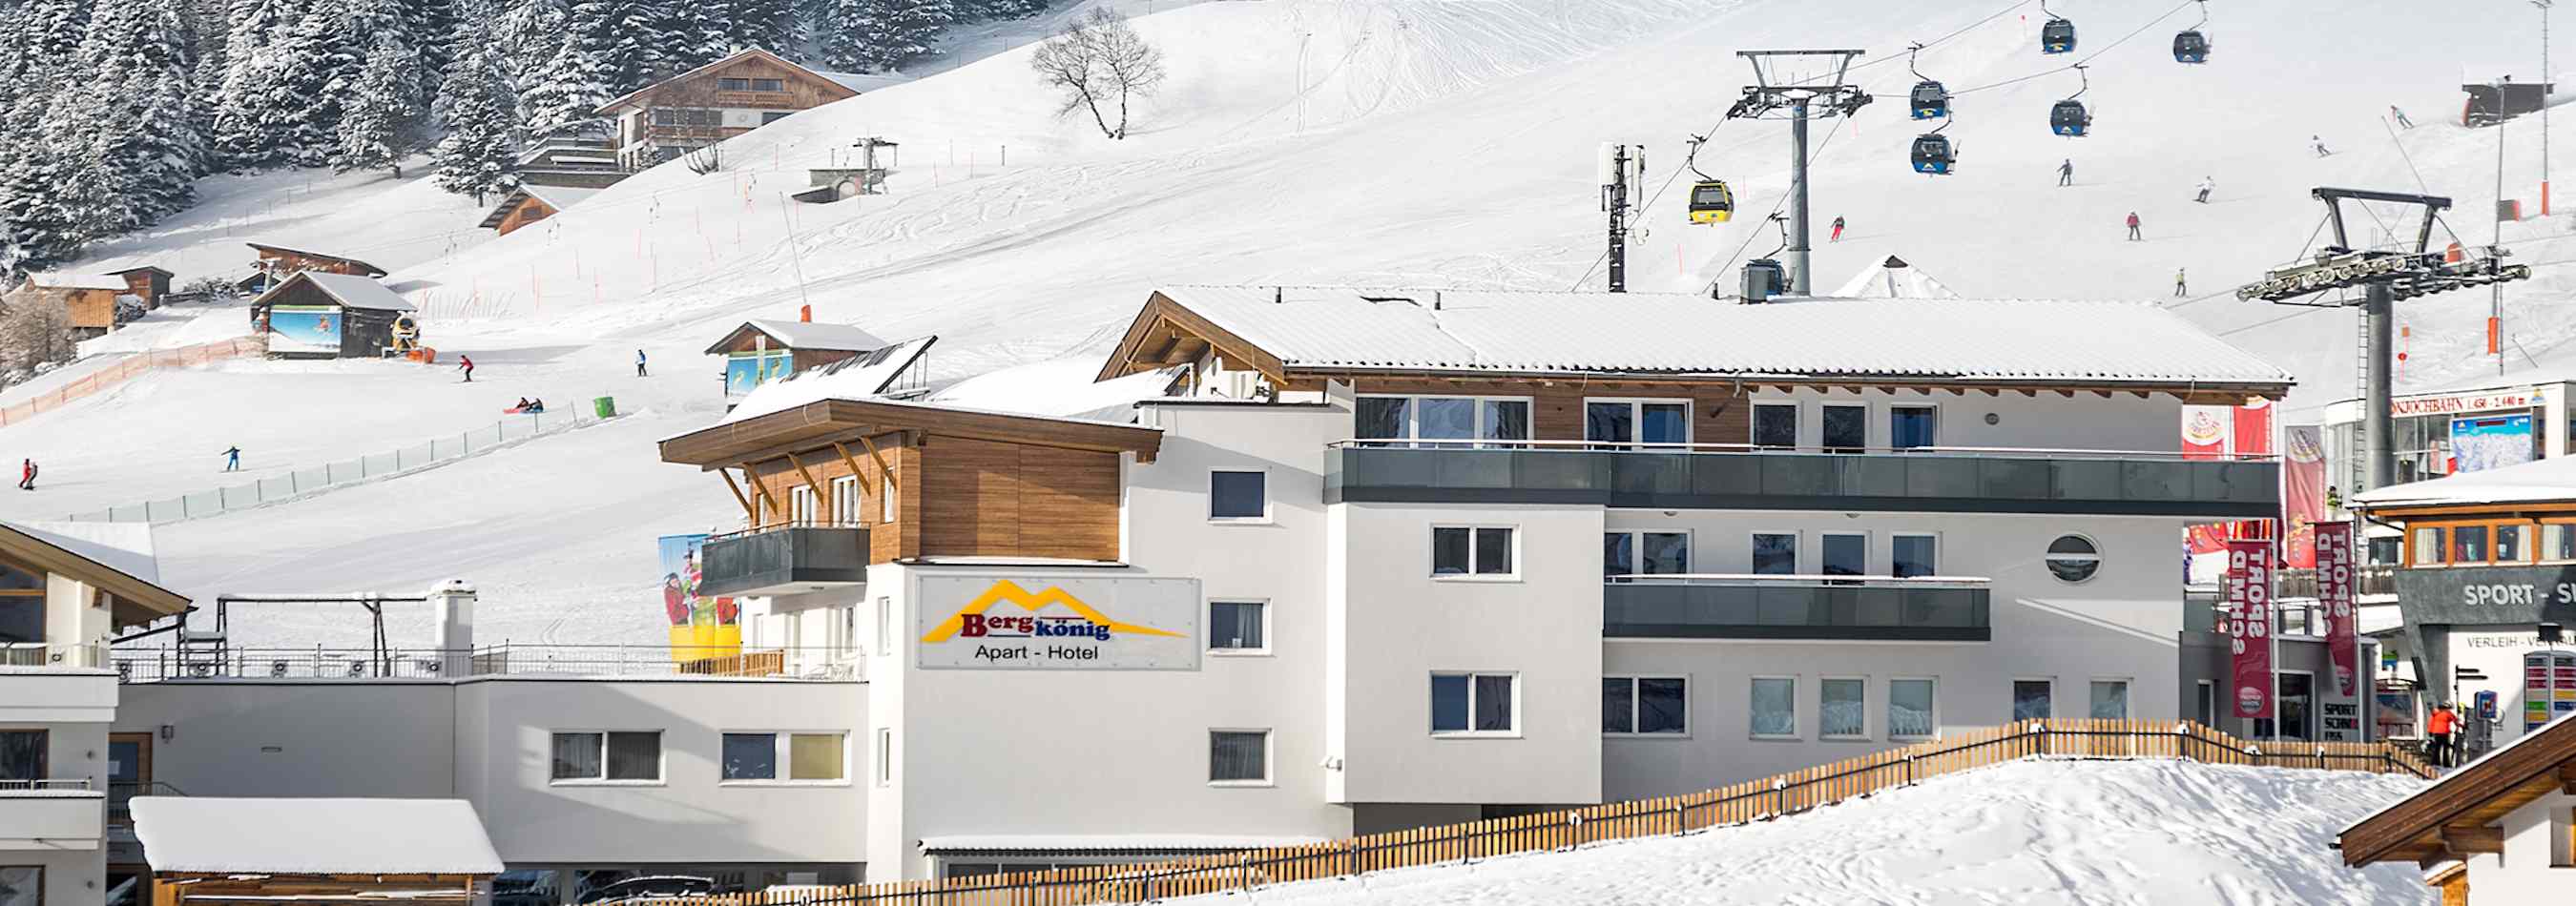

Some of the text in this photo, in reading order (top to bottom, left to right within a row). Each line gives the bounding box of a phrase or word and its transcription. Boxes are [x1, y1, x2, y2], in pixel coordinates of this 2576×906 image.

[2464, 584, 2535, 605] SPORT
[2467, 636, 2518, 648] VERLEIH
[975, 645, 1028, 660] Apart
[1049, 645, 1098, 660] Hotel
